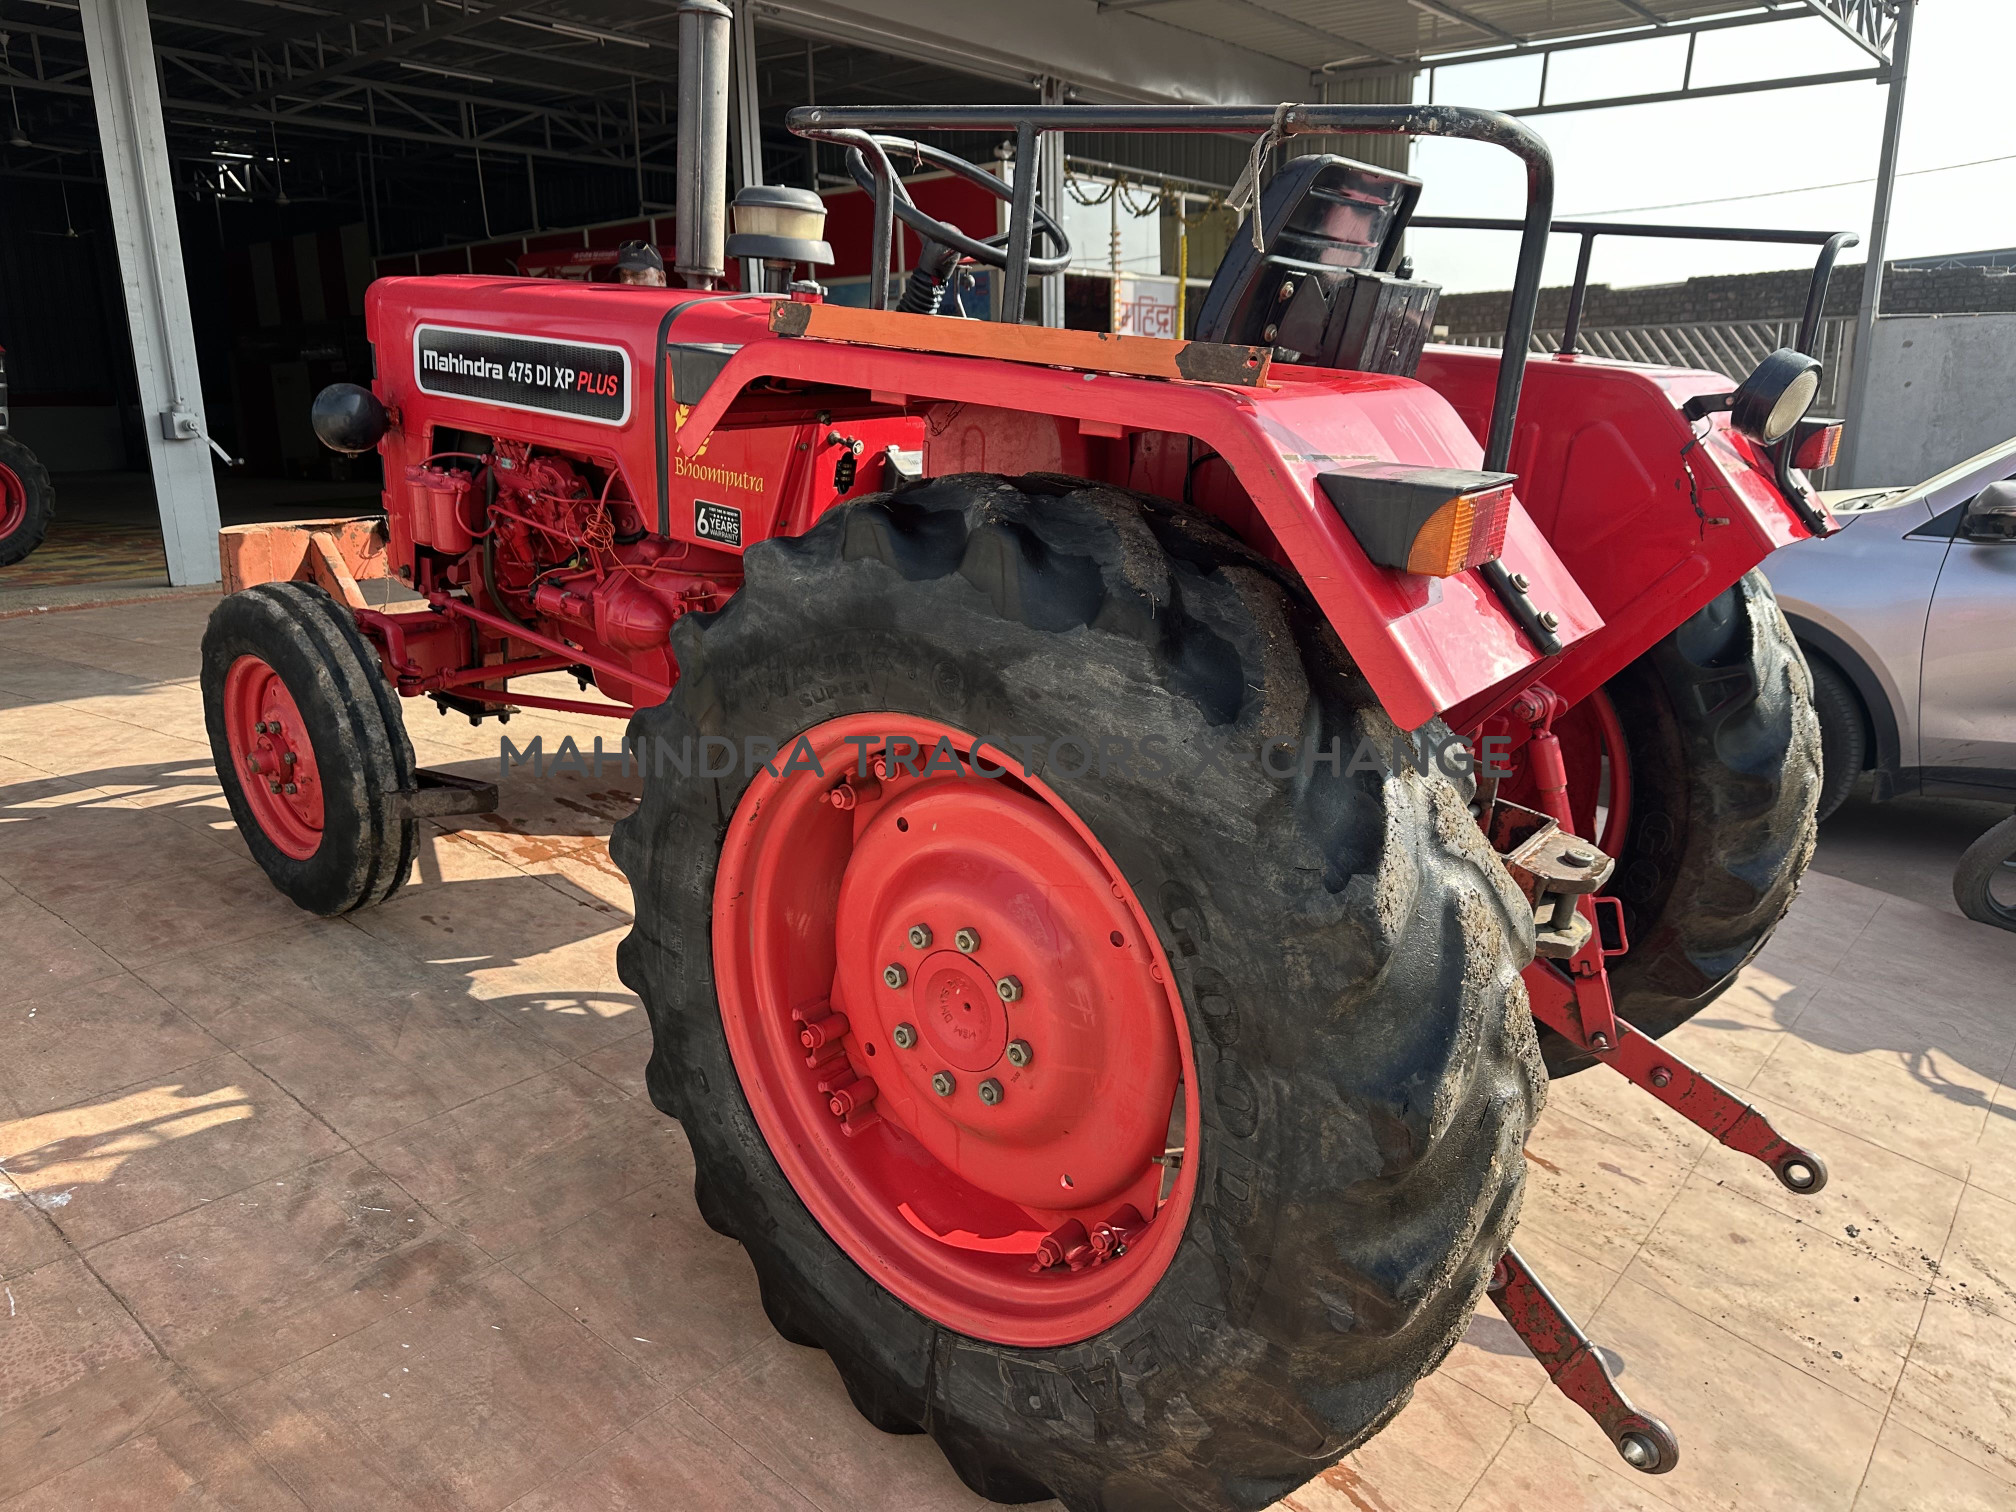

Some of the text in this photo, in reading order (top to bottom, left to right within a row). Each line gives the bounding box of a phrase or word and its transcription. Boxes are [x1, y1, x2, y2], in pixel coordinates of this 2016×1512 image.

[423, 350, 618, 396] Mahindra 475 DI XP PLUS
[674, 456, 764, 493] Bhoomiputra
[697, 507, 709, 535] 6
